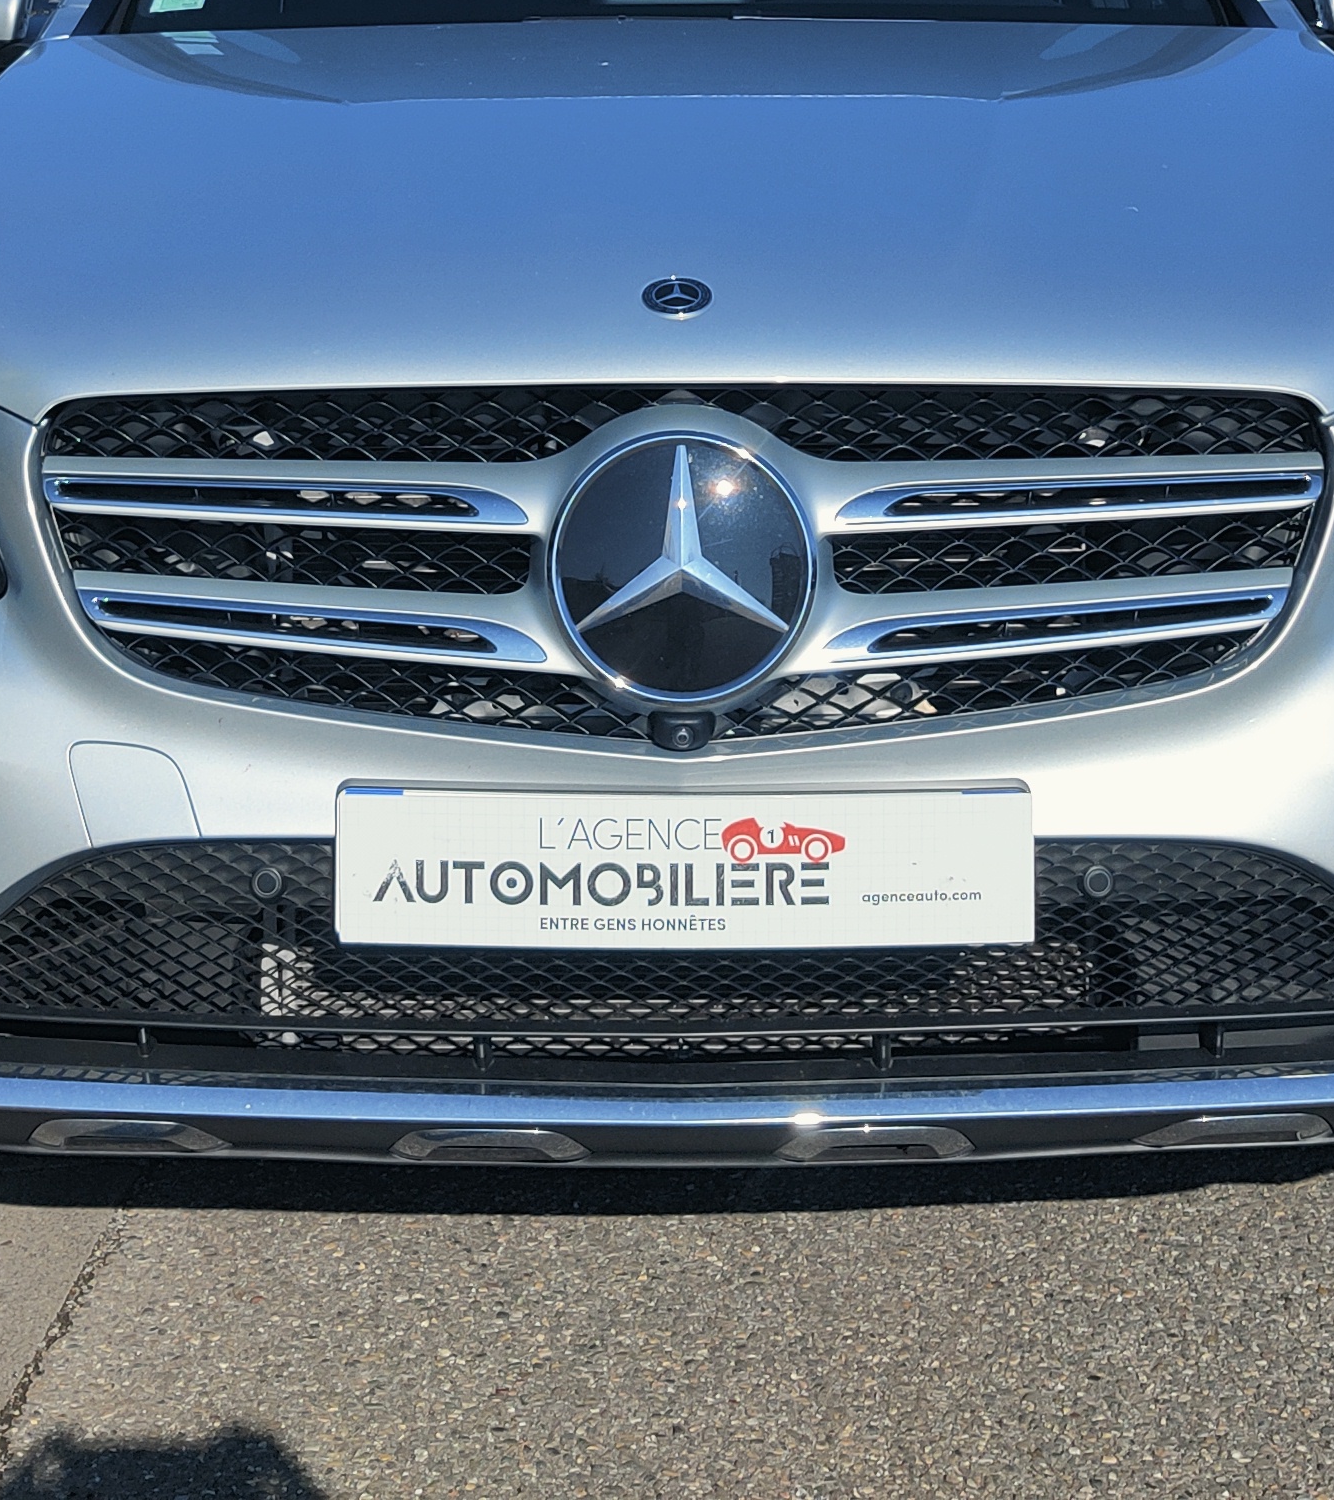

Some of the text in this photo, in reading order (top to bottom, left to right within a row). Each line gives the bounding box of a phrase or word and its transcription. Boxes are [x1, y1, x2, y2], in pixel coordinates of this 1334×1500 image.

[539, 817, 723, 851] L'AGENCE
[861, 888, 983, 906] agenceauto.com
[539, 914, 727, 931] ENTRE GENS HONNÊTES
